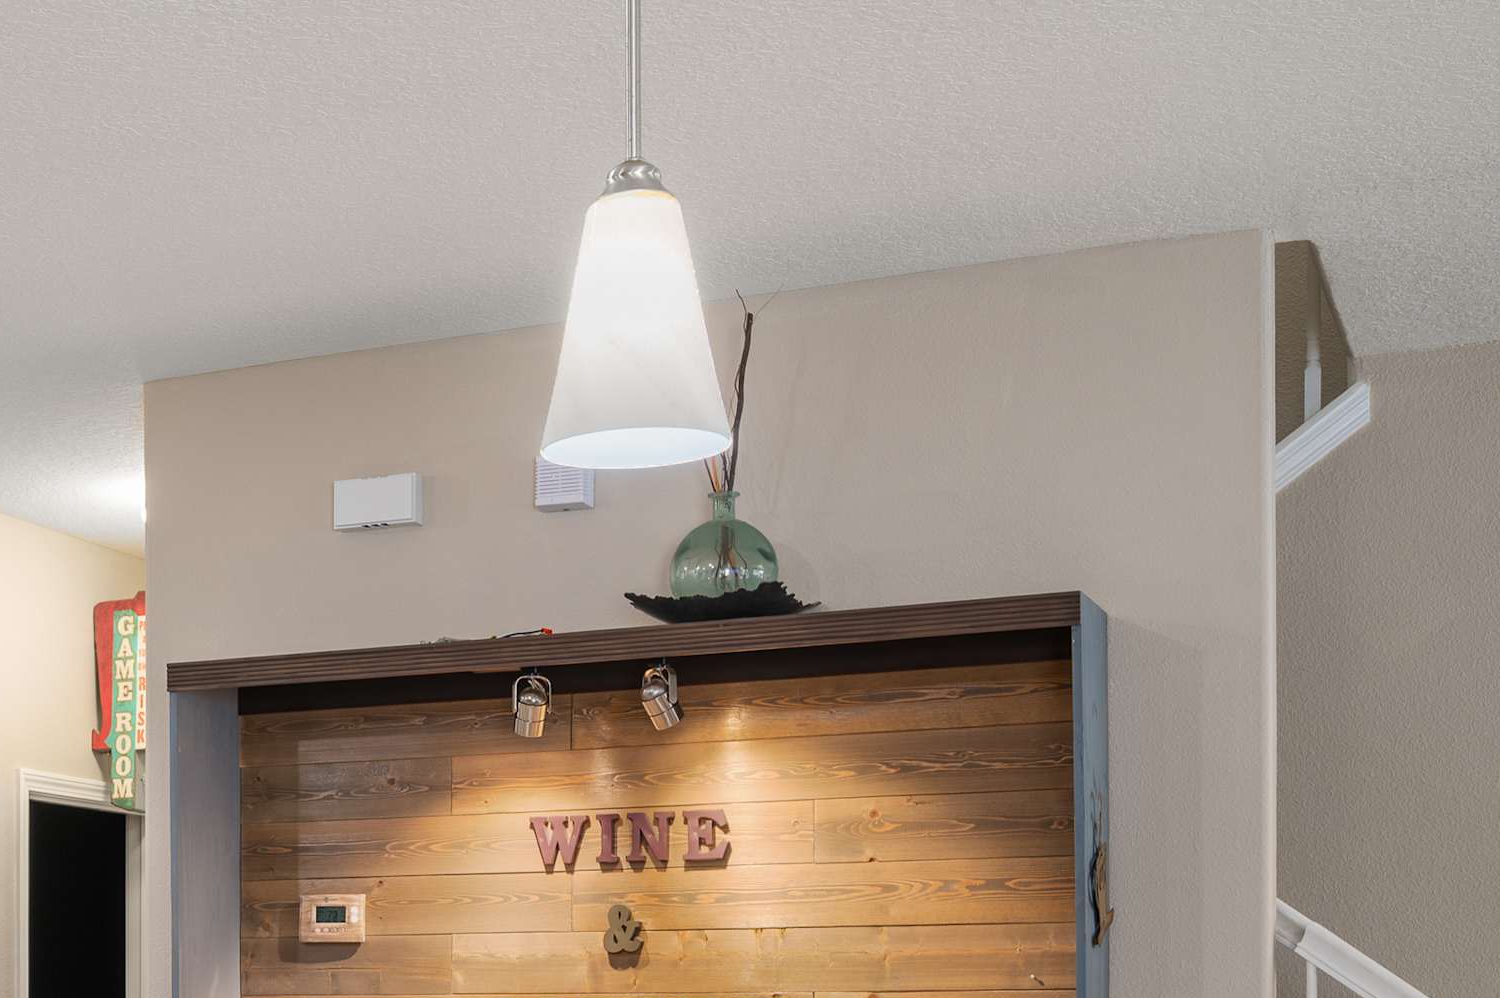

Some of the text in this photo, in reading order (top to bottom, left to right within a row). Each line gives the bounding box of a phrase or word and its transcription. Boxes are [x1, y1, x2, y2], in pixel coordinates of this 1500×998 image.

[112, 615, 135, 799] GAME ROOM
[529, 809, 732, 864] WINE
[603, 904, 644, 953] &
